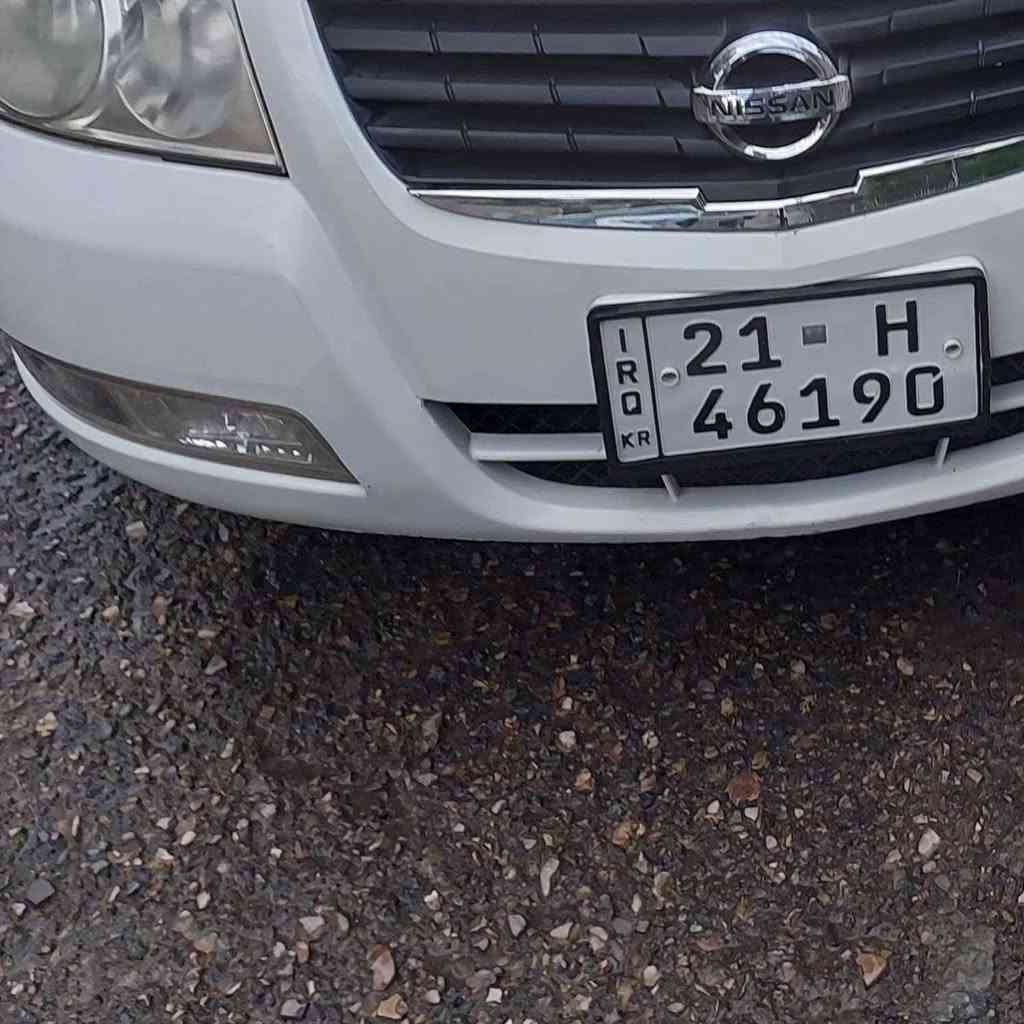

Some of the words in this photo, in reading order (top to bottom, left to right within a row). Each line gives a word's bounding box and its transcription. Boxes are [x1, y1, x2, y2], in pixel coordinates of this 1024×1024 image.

[710, 88, 834, 117] NISSAN
[683, 316, 782, 376] 21
[875, 300, 920, 356] H
[692, 365, 945, 440] 46190
[620, 430, 651, 449] KR
